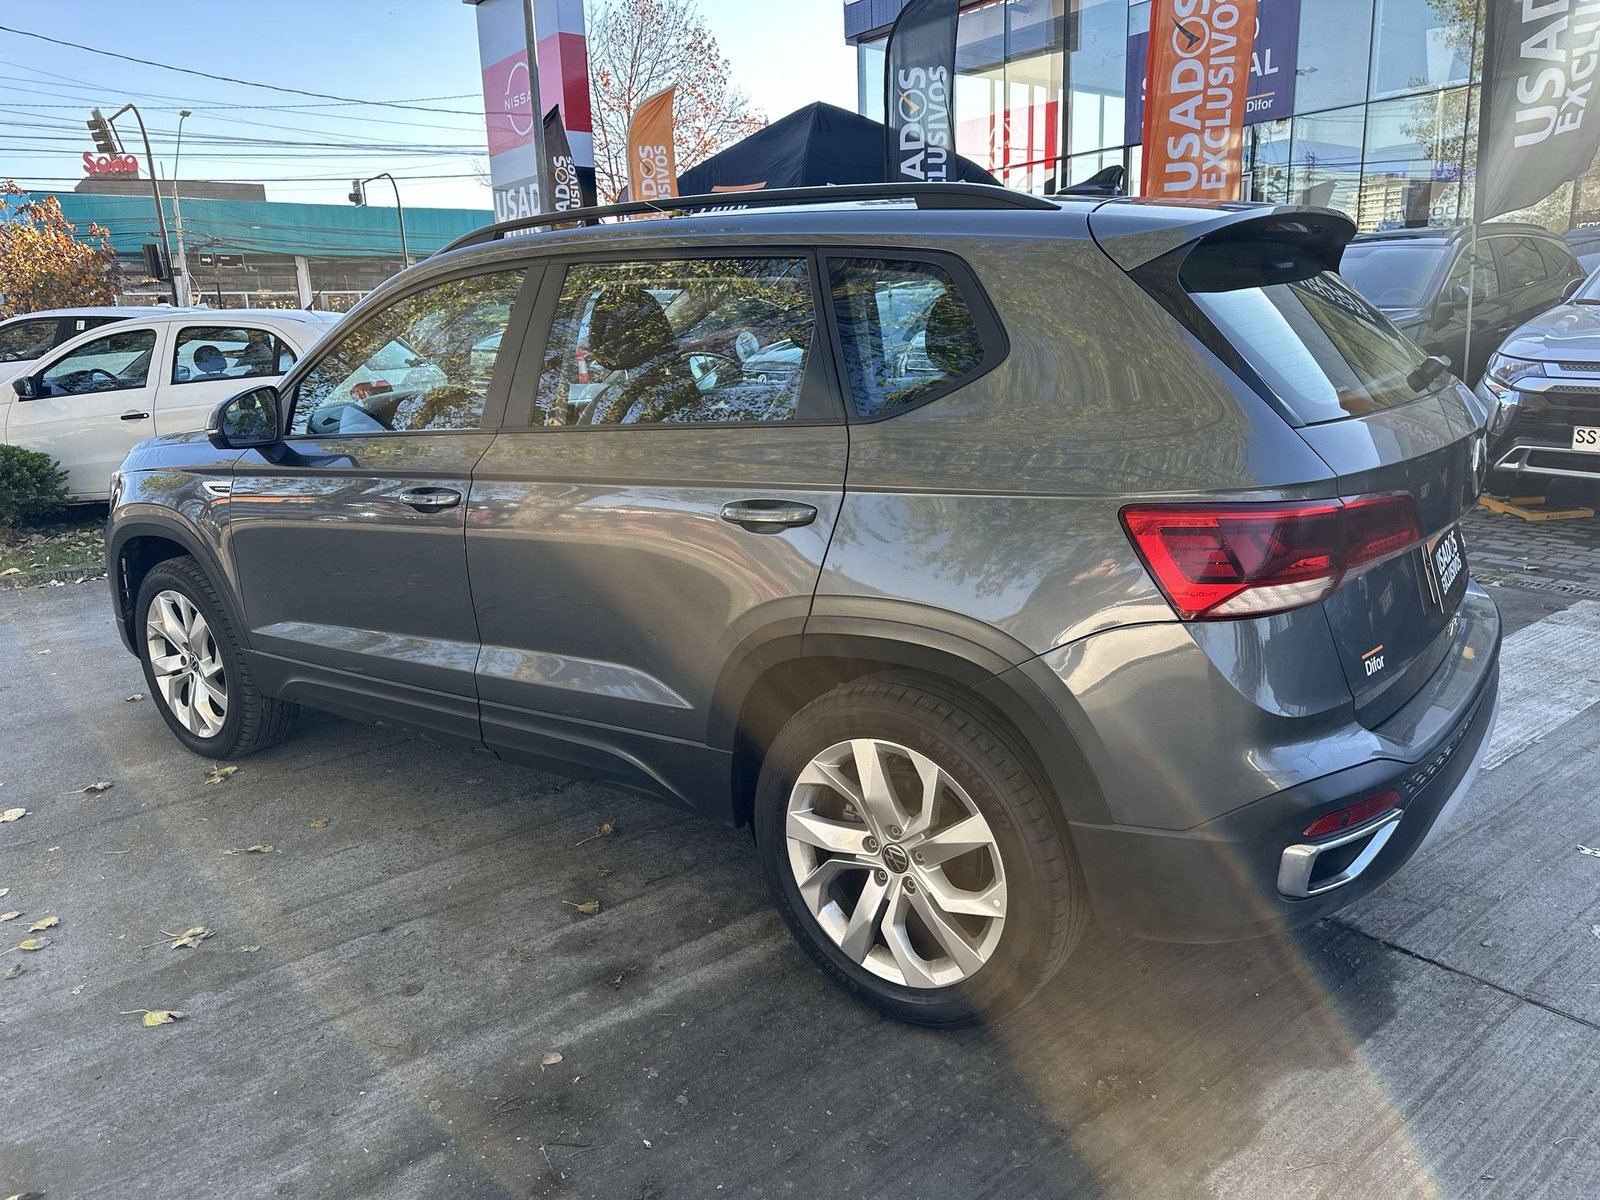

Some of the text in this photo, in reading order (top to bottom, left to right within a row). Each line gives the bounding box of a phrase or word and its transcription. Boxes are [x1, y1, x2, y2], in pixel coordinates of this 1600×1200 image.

[1201, 0, 1240, 190] EXCLUSIVO
[1246, 97, 1274, 113] Difor
[639, 145, 658, 199] DOS
[1364, 655, 1385, 677] Difor
